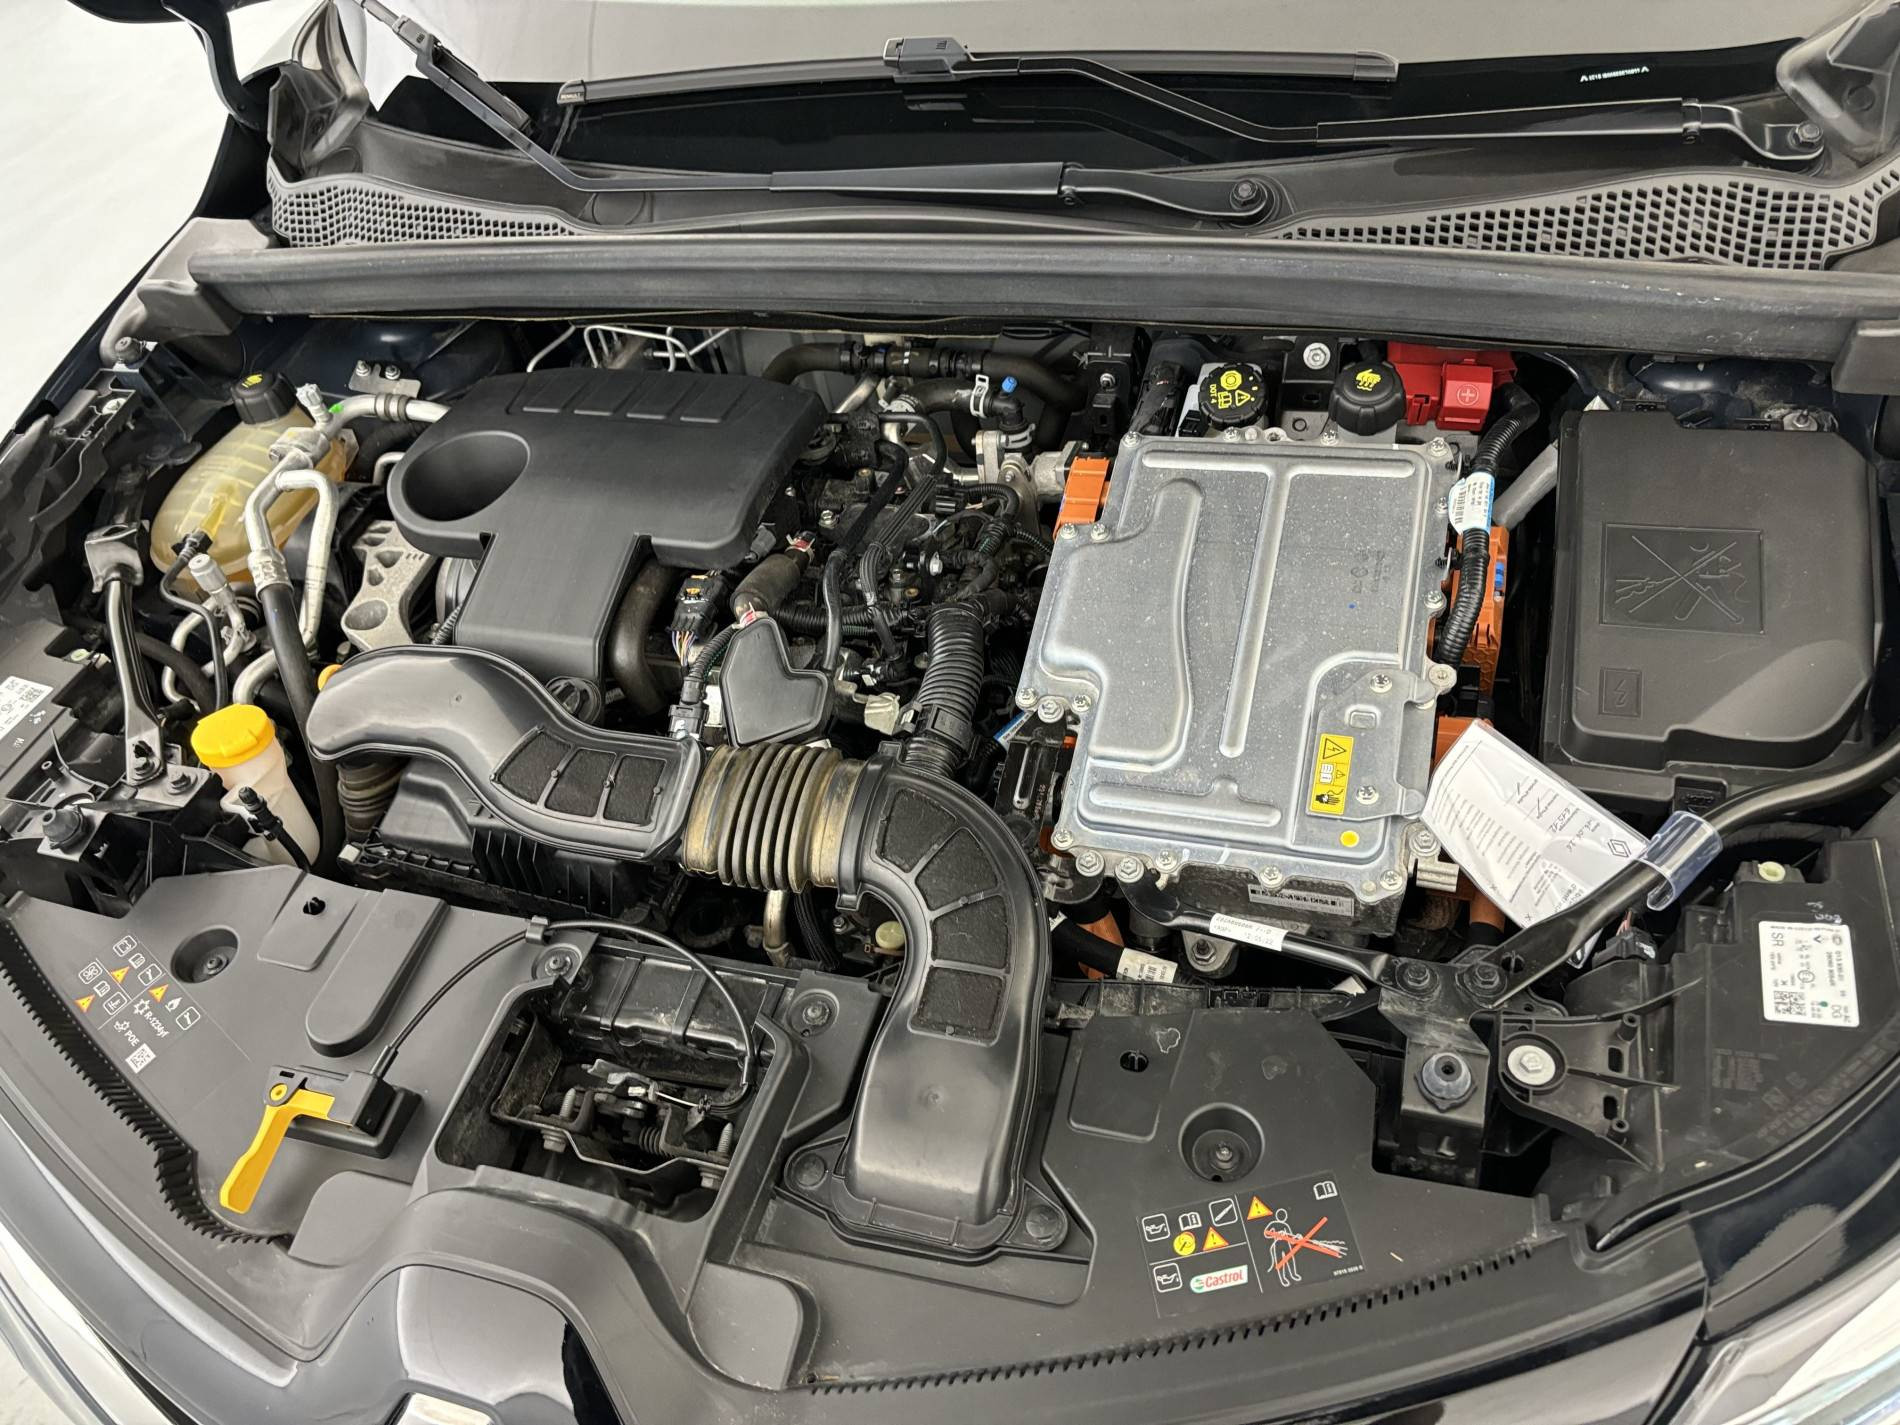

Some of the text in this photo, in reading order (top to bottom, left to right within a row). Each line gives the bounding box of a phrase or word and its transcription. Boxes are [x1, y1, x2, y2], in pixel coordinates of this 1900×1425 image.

[1771, 932, 1784, 947] SR
[144, 1011, 170, 1038] R-1234yf
[124, 1030, 140, 1046] POE
[1205, 1269, 1244, 1288] Castrol
